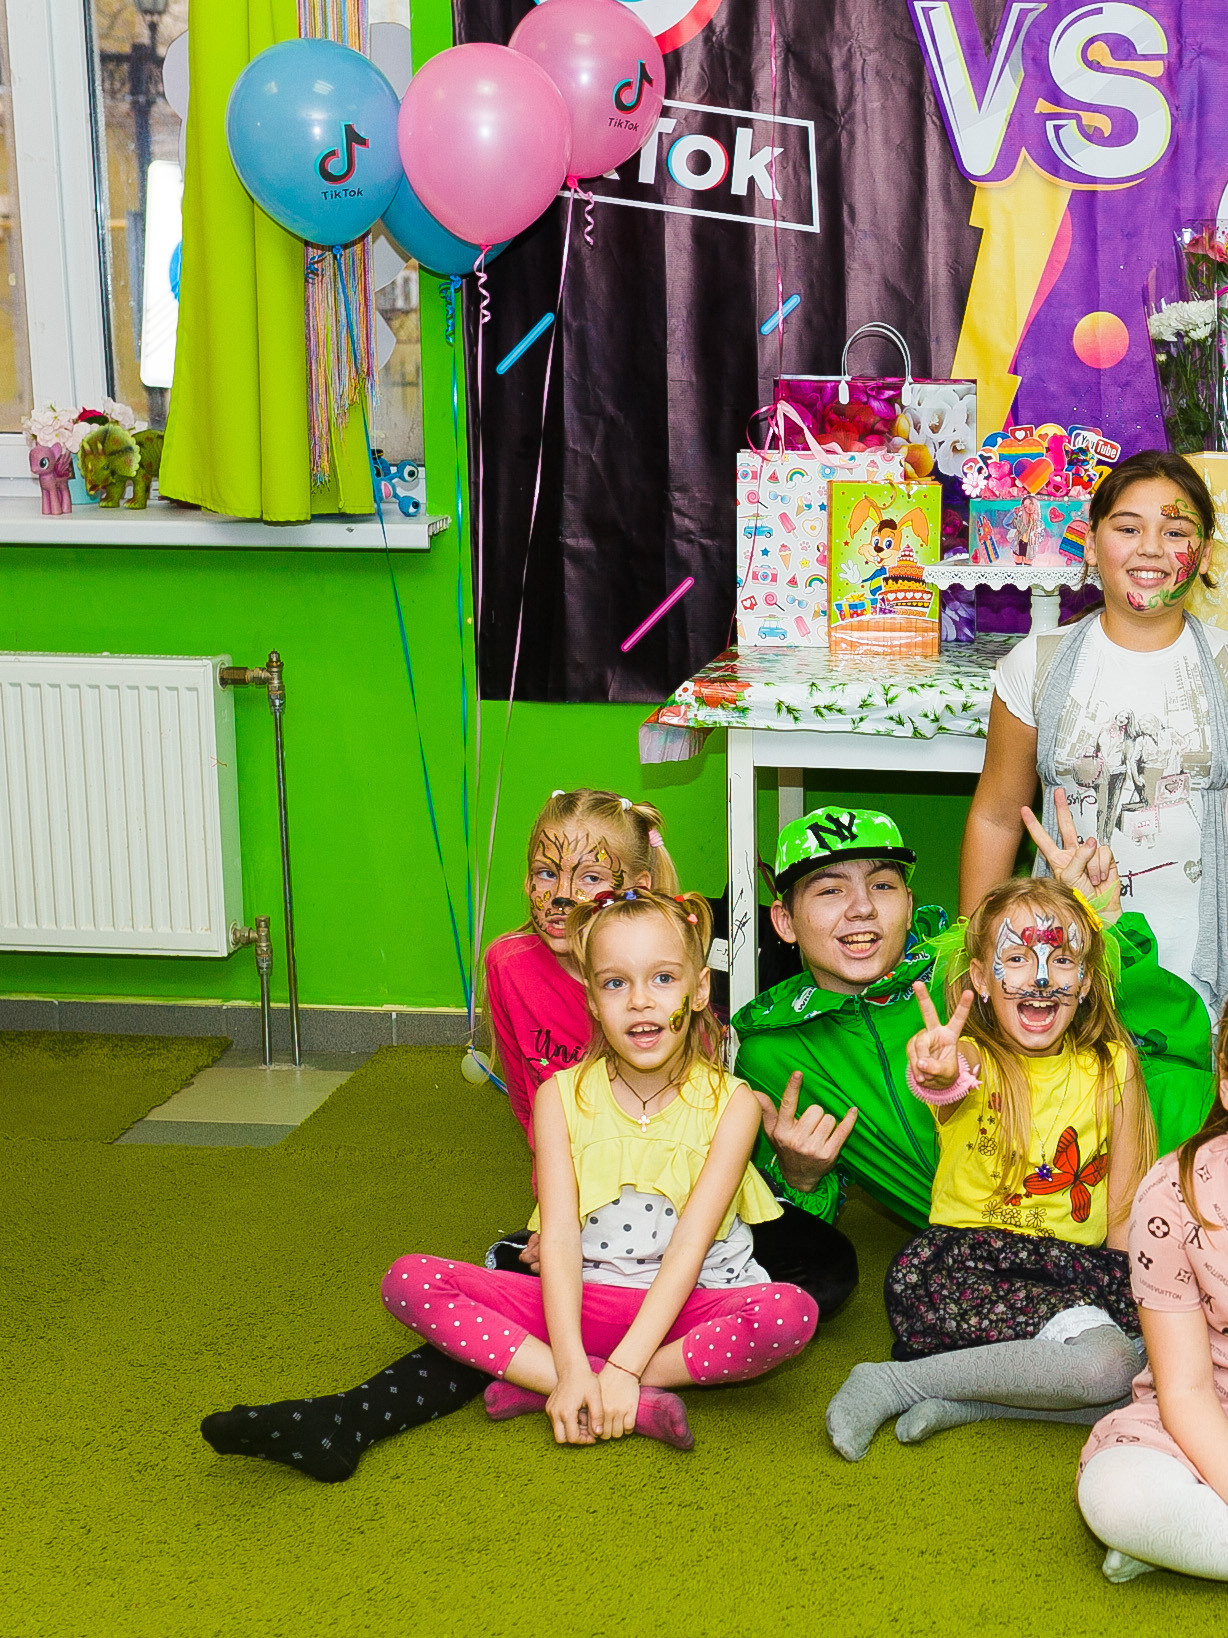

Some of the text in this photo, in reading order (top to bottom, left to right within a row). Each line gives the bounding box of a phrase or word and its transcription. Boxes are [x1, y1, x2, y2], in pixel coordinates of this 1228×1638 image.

[910, 0, 1176, 186] VS
[606, 117, 639, 132] TikTok
[321, 187, 364, 201] TikTok
[1096, 440, 1118, 459] Tube
[805, 811, 859, 850] NY
[530, 1028, 588, 1064] Uni
